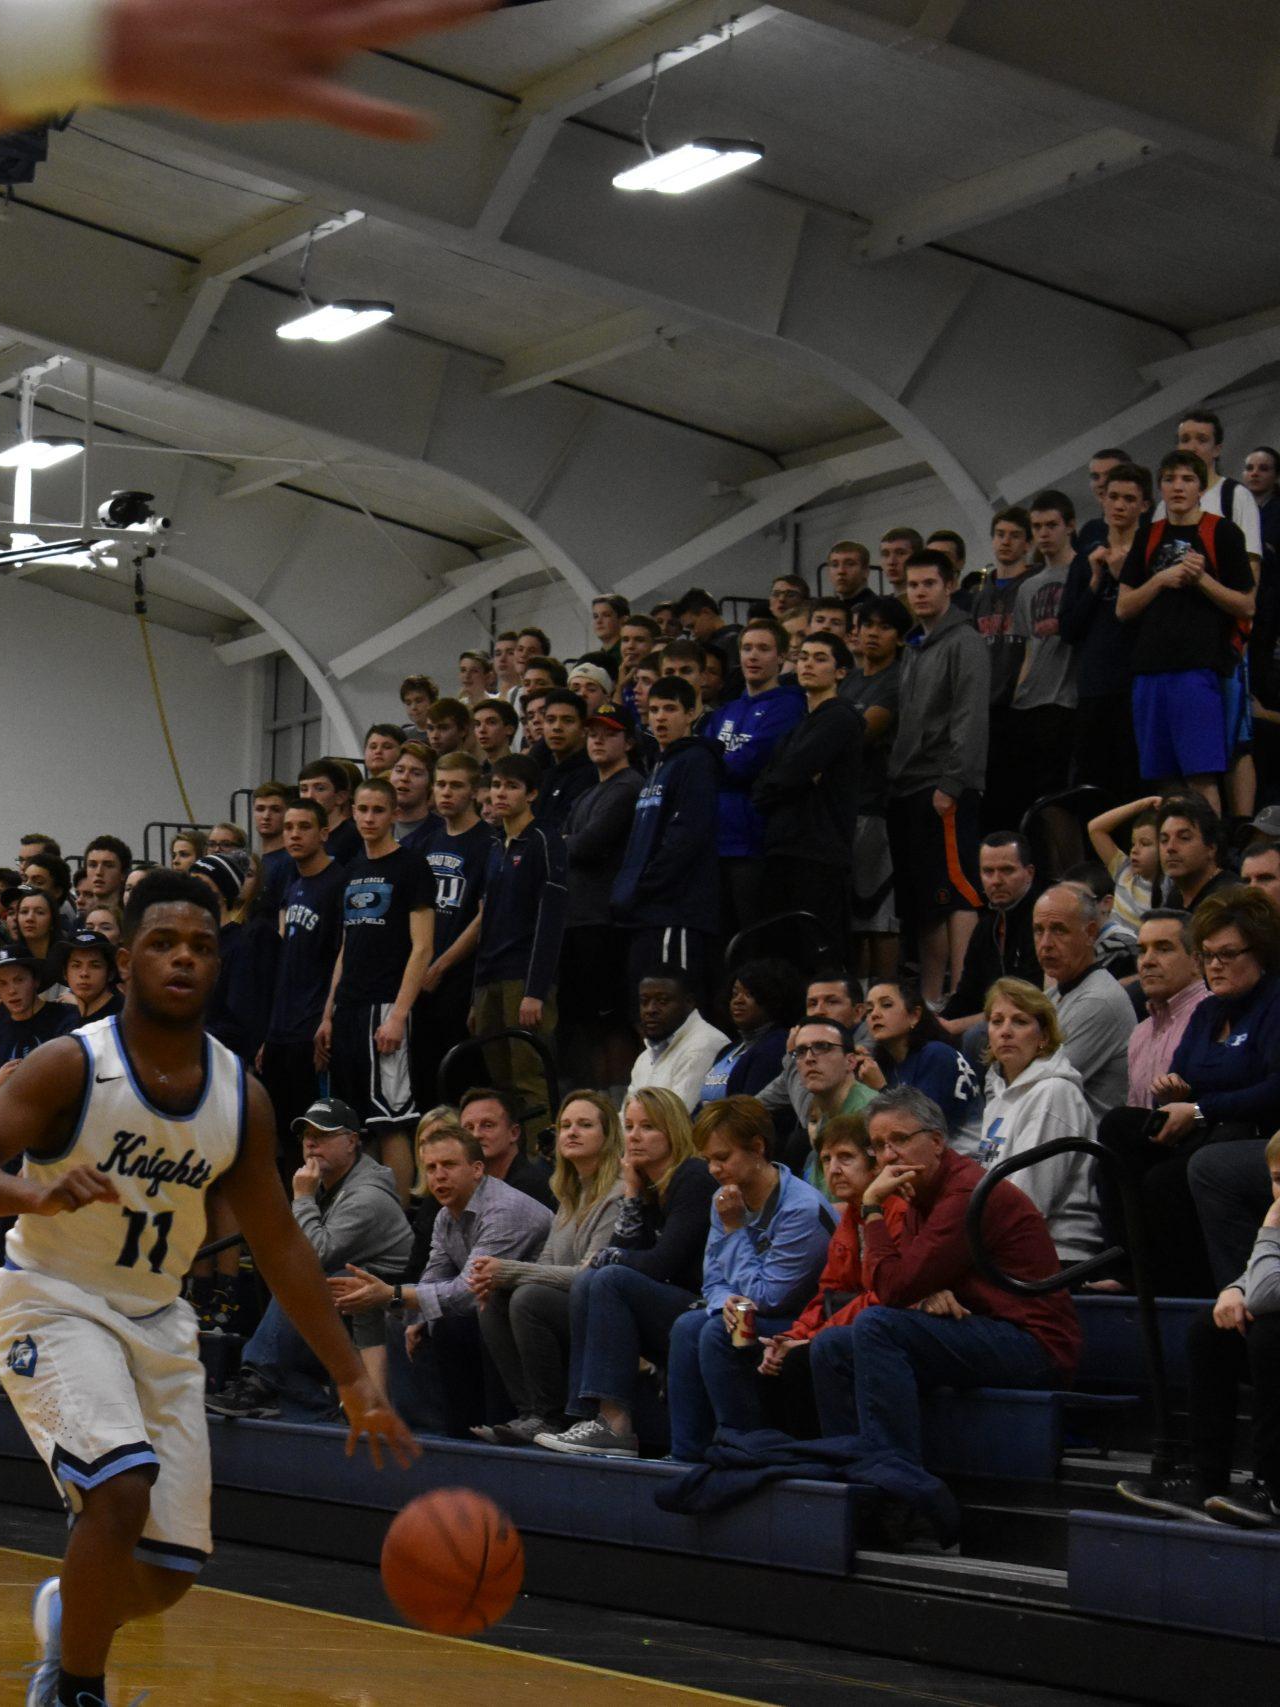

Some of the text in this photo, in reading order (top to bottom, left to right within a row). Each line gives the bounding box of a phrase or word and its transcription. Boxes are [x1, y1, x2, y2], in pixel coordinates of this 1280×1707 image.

[285, 904, 319, 931] IGHTS
[97, 1130, 212, 1197] Knights
[116, 1206, 174, 1274] 11
